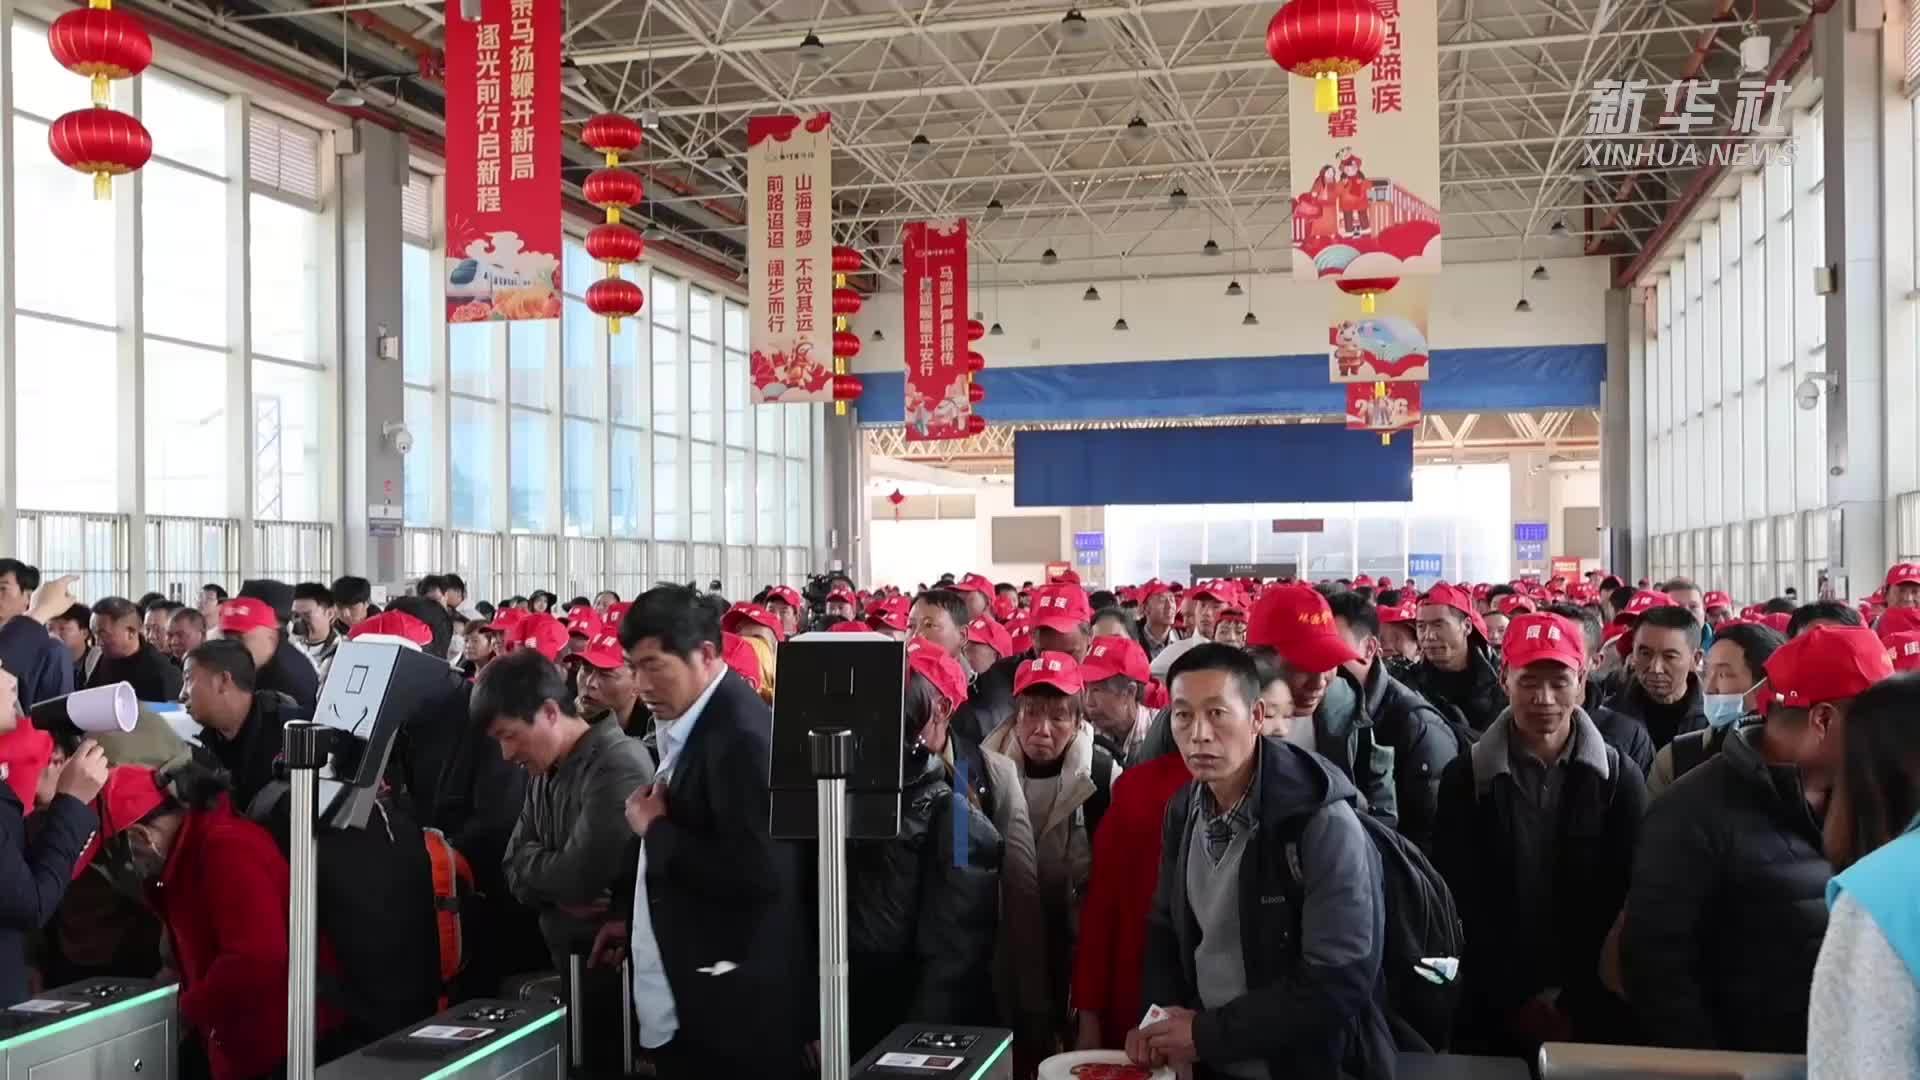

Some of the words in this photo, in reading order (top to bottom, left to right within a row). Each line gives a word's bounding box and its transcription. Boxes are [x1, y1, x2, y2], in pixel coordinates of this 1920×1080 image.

[476, 24, 501, 213] 逐光前行启新程
[767, 175, 784, 249] 前路迢迢
[795, 173, 813, 248] 山海寻梦
[768, 259, 784, 333] 阔步而行
[796, 258, 814, 332] 不觉其远
